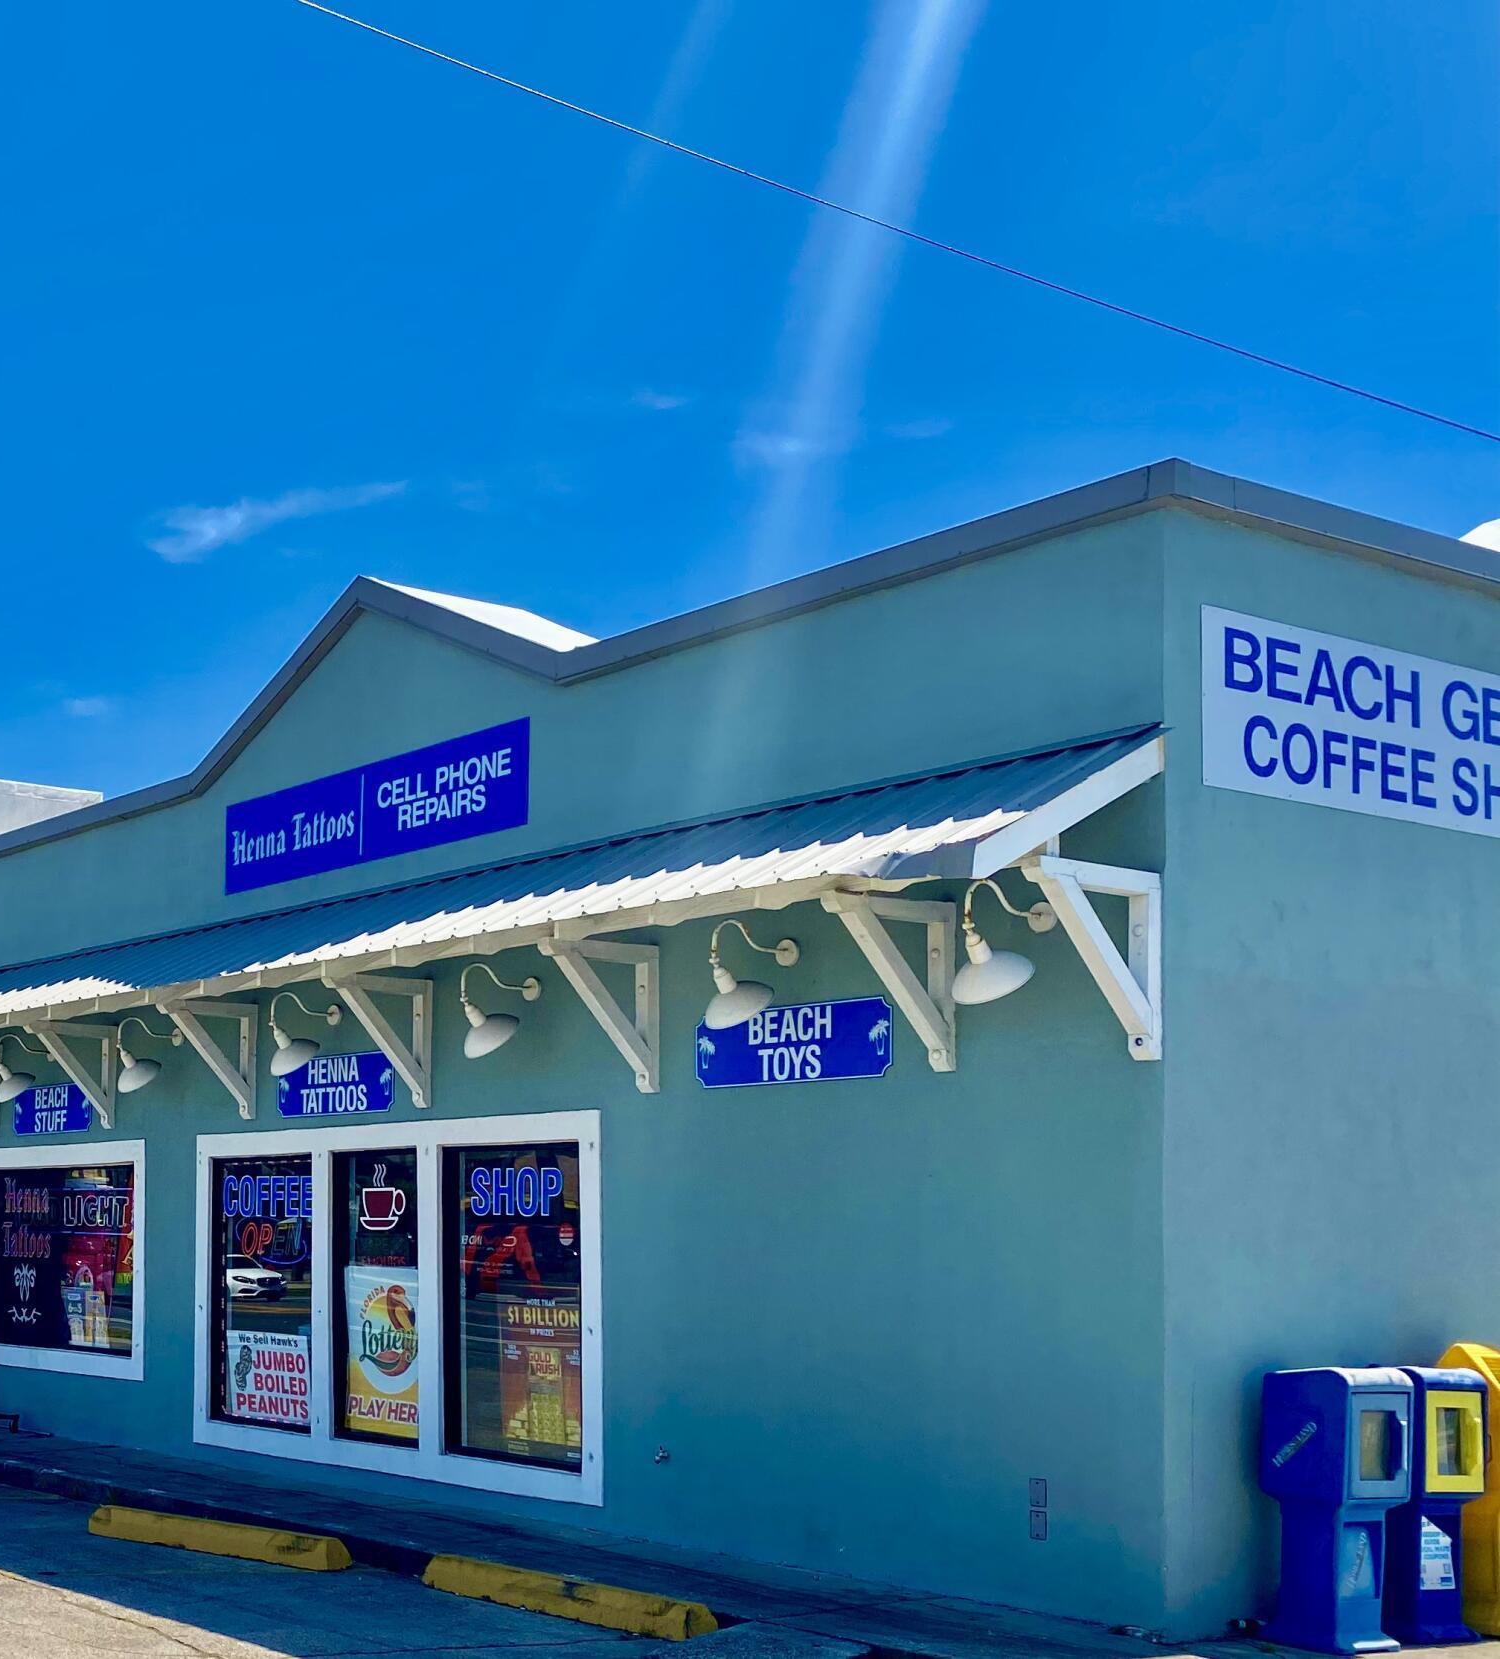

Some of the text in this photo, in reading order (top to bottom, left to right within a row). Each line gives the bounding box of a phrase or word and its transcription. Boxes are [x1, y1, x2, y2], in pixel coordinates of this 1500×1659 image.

[1224, 626, 1421, 728] BEACH
[377, 748, 512, 808] CELL PHONE
[1243, 715, 1437, 809] COFFEE
[398, 784, 486, 831] REPAIRS
[232, 810, 355, 866] Henna Tattoos
[748, 1005, 832, 1046] BEACH
[307, 1057, 360, 1084] HENNA
[758, 1044, 821, 1082] TOYS
[34, 1087, 69, 1110] BEACH
[300, 1083, 368, 1114] TATTOOS
[34, 1109, 68, 1134] STUFF
[3, 1177, 50, 1214] Henna
[223, 1175, 312, 1218] COFFEE
[470, 1166, 564, 1217] SHOP
[63, 1195, 130, 1228] LIGHT
[2, 1220, 51, 1259] Tattoos
[241, 1220, 303, 1258] OPEN
[360, 1286, 386, 1320] FLORIDA
[507, 1306, 580, 1328] $1 BILLION
[238, 1334, 299, 1348] We Sell Hawk's
[359, 1319, 418, 1364] Lottery
[528, 1352, 551, 1363] GOLD
[252, 1350, 306, 1374] JUMBO
[536, 1363, 560, 1376] RUSH
[254, 1374, 308, 1396] BOILED
[236, 1393, 309, 1419] PEANUTS
[348, 1396, 418, 1424] PLAY HER
